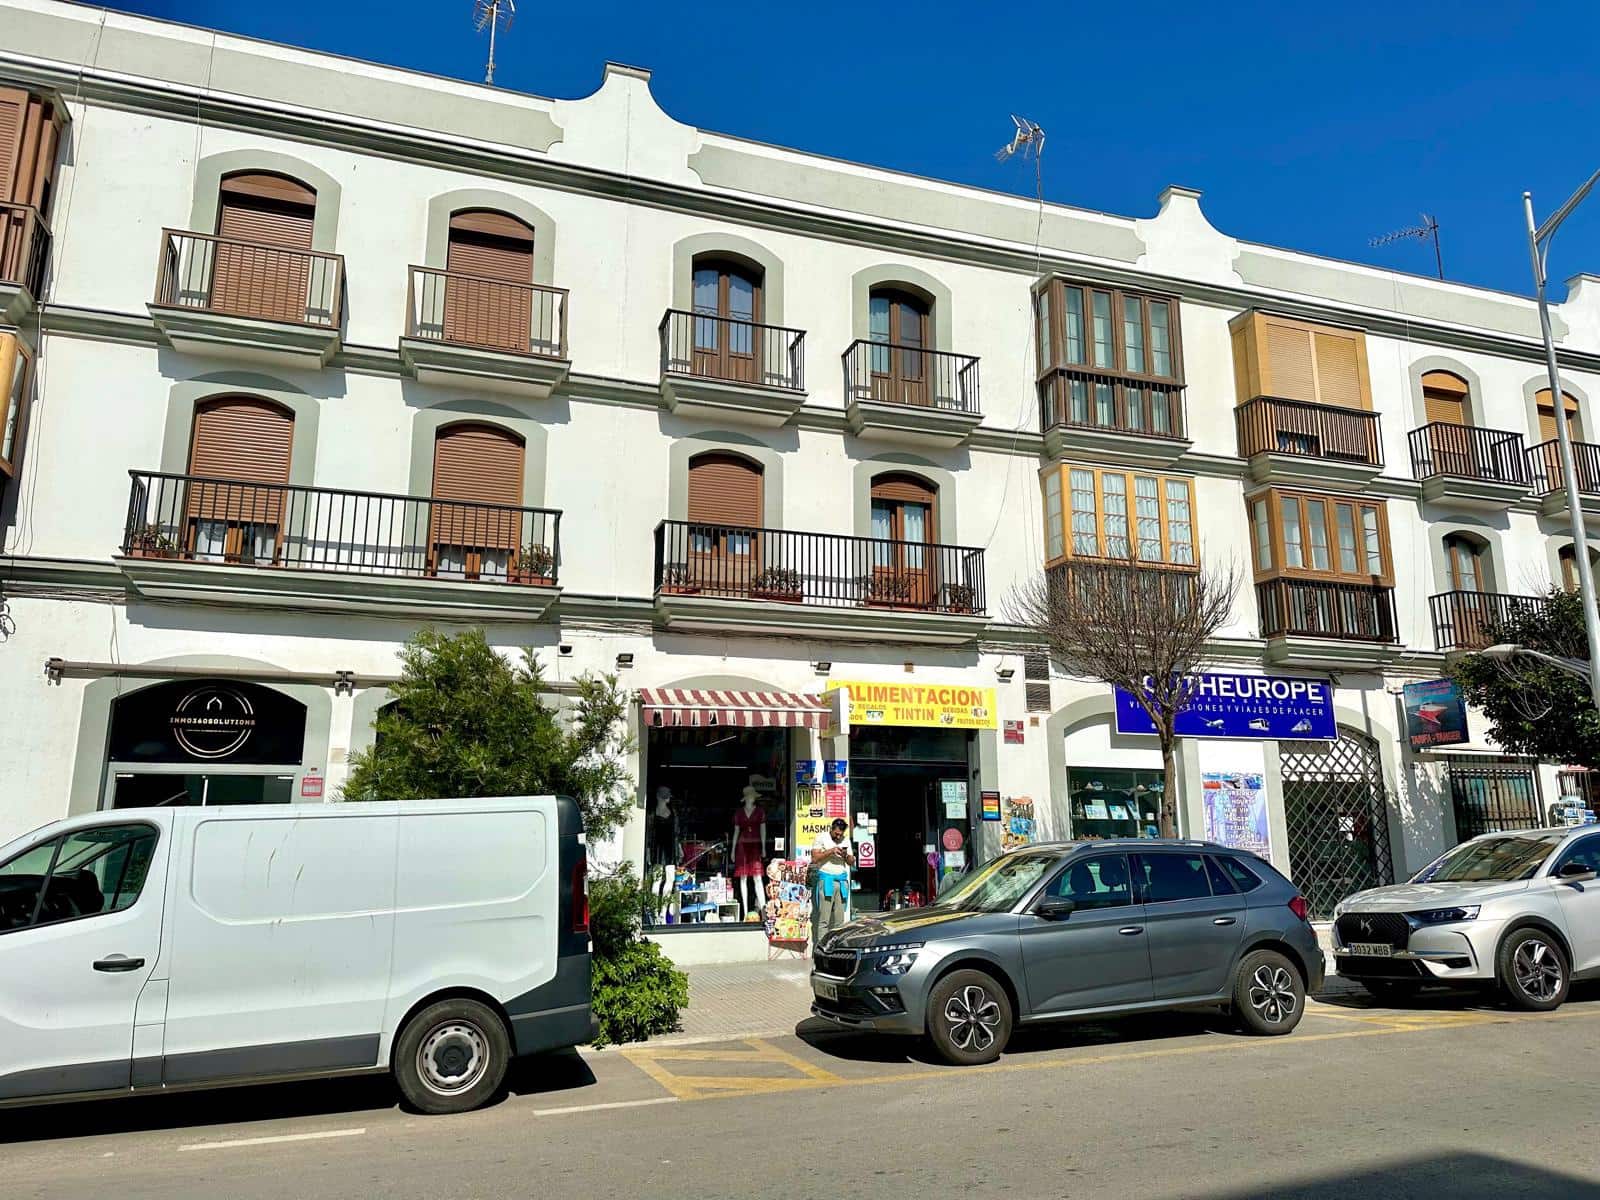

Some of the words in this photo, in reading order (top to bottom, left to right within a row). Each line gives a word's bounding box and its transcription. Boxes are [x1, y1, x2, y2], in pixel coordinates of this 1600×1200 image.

[846, 685, 984, 707] ALIMENTACION
[893, 707, 935, 721] TINTIN
[1234, 706, 1270, 714] VIAJES
[1272, 707, 1284, 715] DE
[1287, 708, 1324, 716] PLACER
